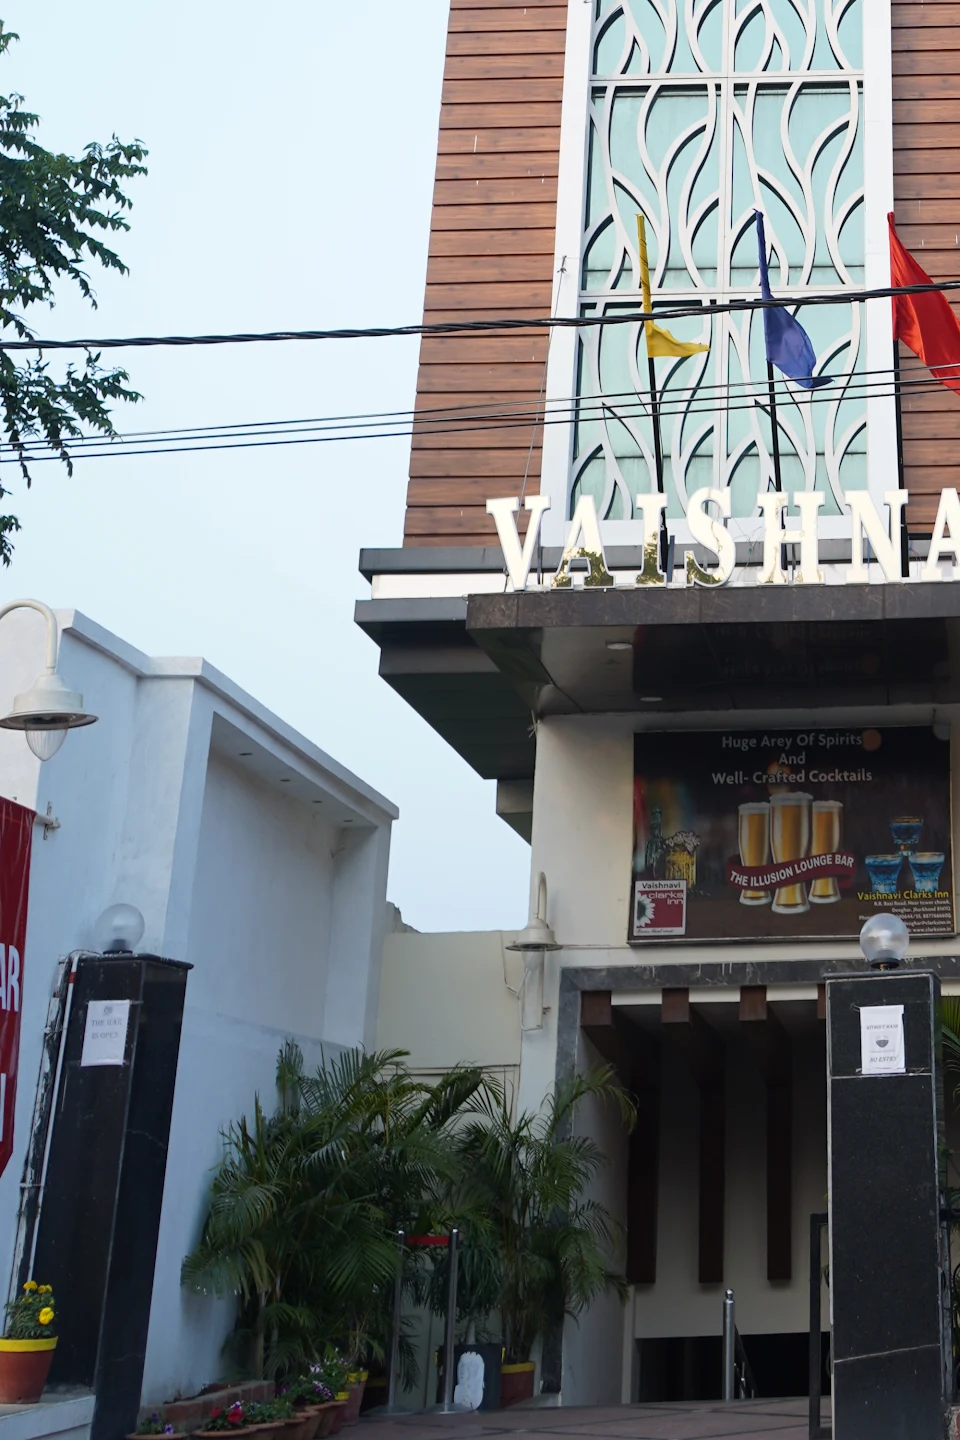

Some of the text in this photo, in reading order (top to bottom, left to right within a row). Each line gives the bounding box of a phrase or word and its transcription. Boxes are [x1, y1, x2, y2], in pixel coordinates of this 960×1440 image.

[722, 733, 862, 751] Huge Arey Of Spirits
[778, 752, 806, 765] And
[753, 769, 805, 784] Crafted
[809, 768, 872, 783] Cocktails
[730, 854, 854, 886] THE ILLUSION LOUNGE BAR
[648, 891, 684, 899] clarks
[857, 890, 949, 900] Vaishnavi Clarks Inn
